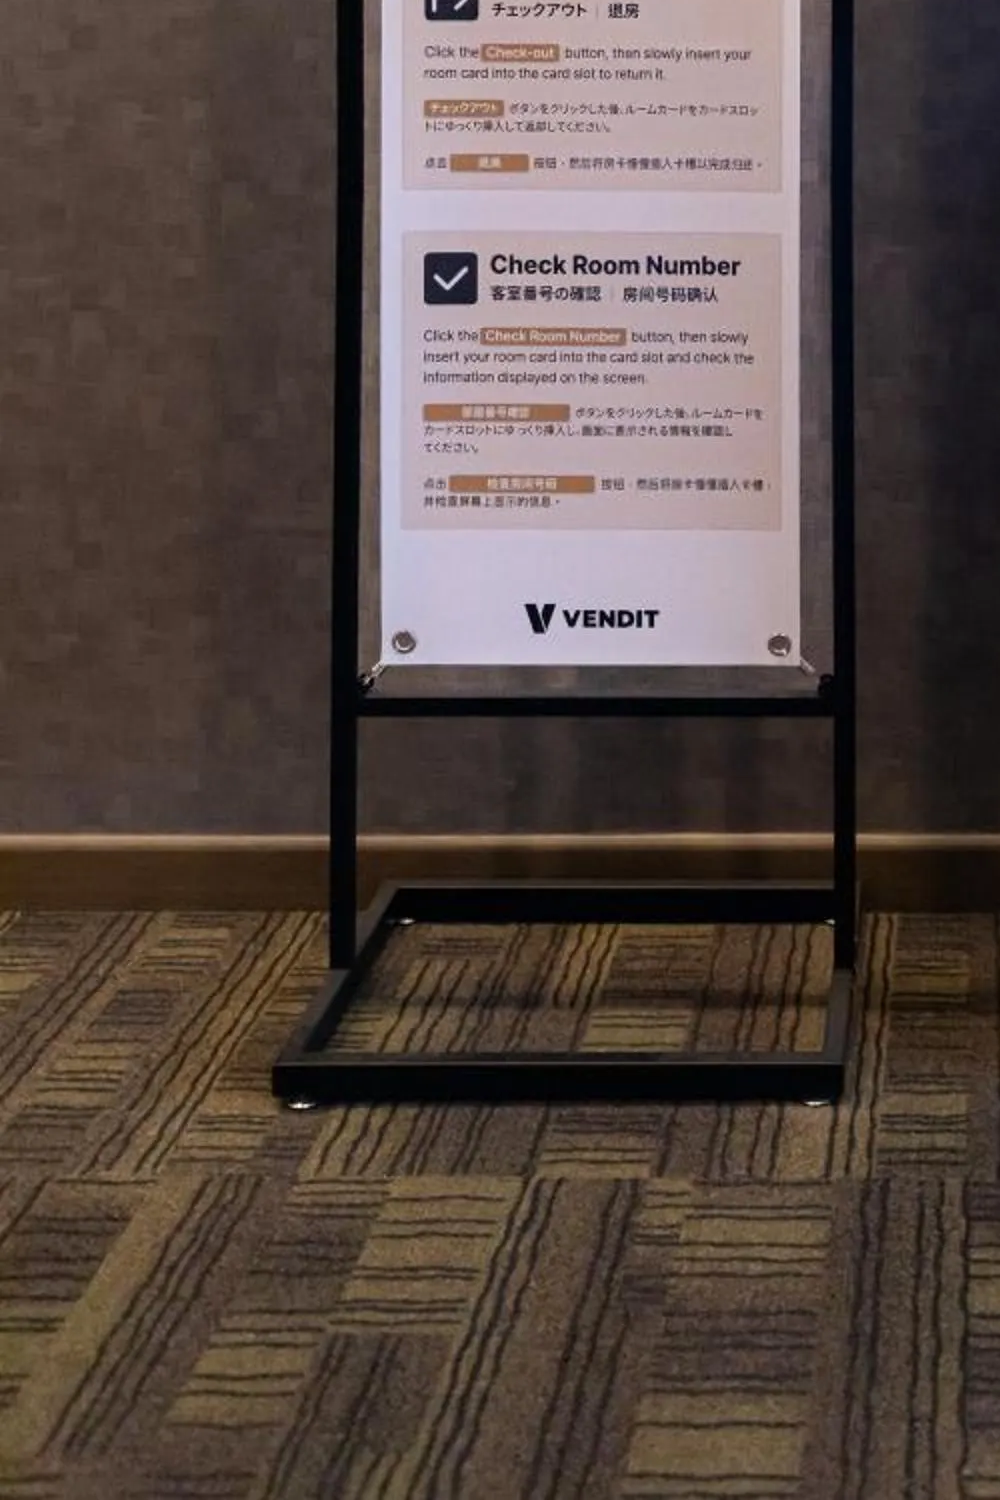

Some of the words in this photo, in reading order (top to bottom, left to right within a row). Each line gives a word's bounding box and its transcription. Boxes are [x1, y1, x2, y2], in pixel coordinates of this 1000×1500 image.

[492, 3, 587, 19] チェックアウト
[424, 46, 455, 60] Click
[458, 47, 479, 60] the
[564, 47, 609, 62] button,
[613, 47, 641, 60] then
[643, 48, 683, 62] slowly
[685, 48, 722, 61] insert
[724, 50, 752, 63] your
[424, 69, 458, 80] room
[460, 67, 489, 80] card
[491, 68, 516, 80] into
[518, 68, 539, 80] the
[541, 68, 571, 80] card
[573, 68, 597, 81] slot
[599, 69, 613, 81] to
[615, 69, 652, 81] return
[490, 253, 567, 275] Check
[572, 254, 640, 275] Room
[646, 254, 741, 276] Number
[423, 329, 455, 342] Click
[457, 329, 479, 343] the
[484, 329, 527, 343] Check
[529, 329, 567, 343] Room
[569, 329, 621, 343] Number
[631, 330, 676, 345] button,
[678, 331, 707, 343] then
[709, 331, 750, 346] slowly
[423, 351, 461, 363] insert
[463, 353, 491, 366] your
[493, 352, 527, 363] room
[528, 351, 557, 363] card
[559, 351, 584, 363] into
[586, 351, 607, 363] the
[609, 351, 638, 364] card
[640, 351, 665, 364] slot
[666, 351, 691, 364] and
[693, 351, 731, 364] check
[733, 352, 755, 365] the
[423, 371, 495, 384] information
[497, 371, 557, 386] displayed
[559, 374, 576, 384] on
[578, 371, 600, 384] the
[562, 609, 660, 630] VENDIT
